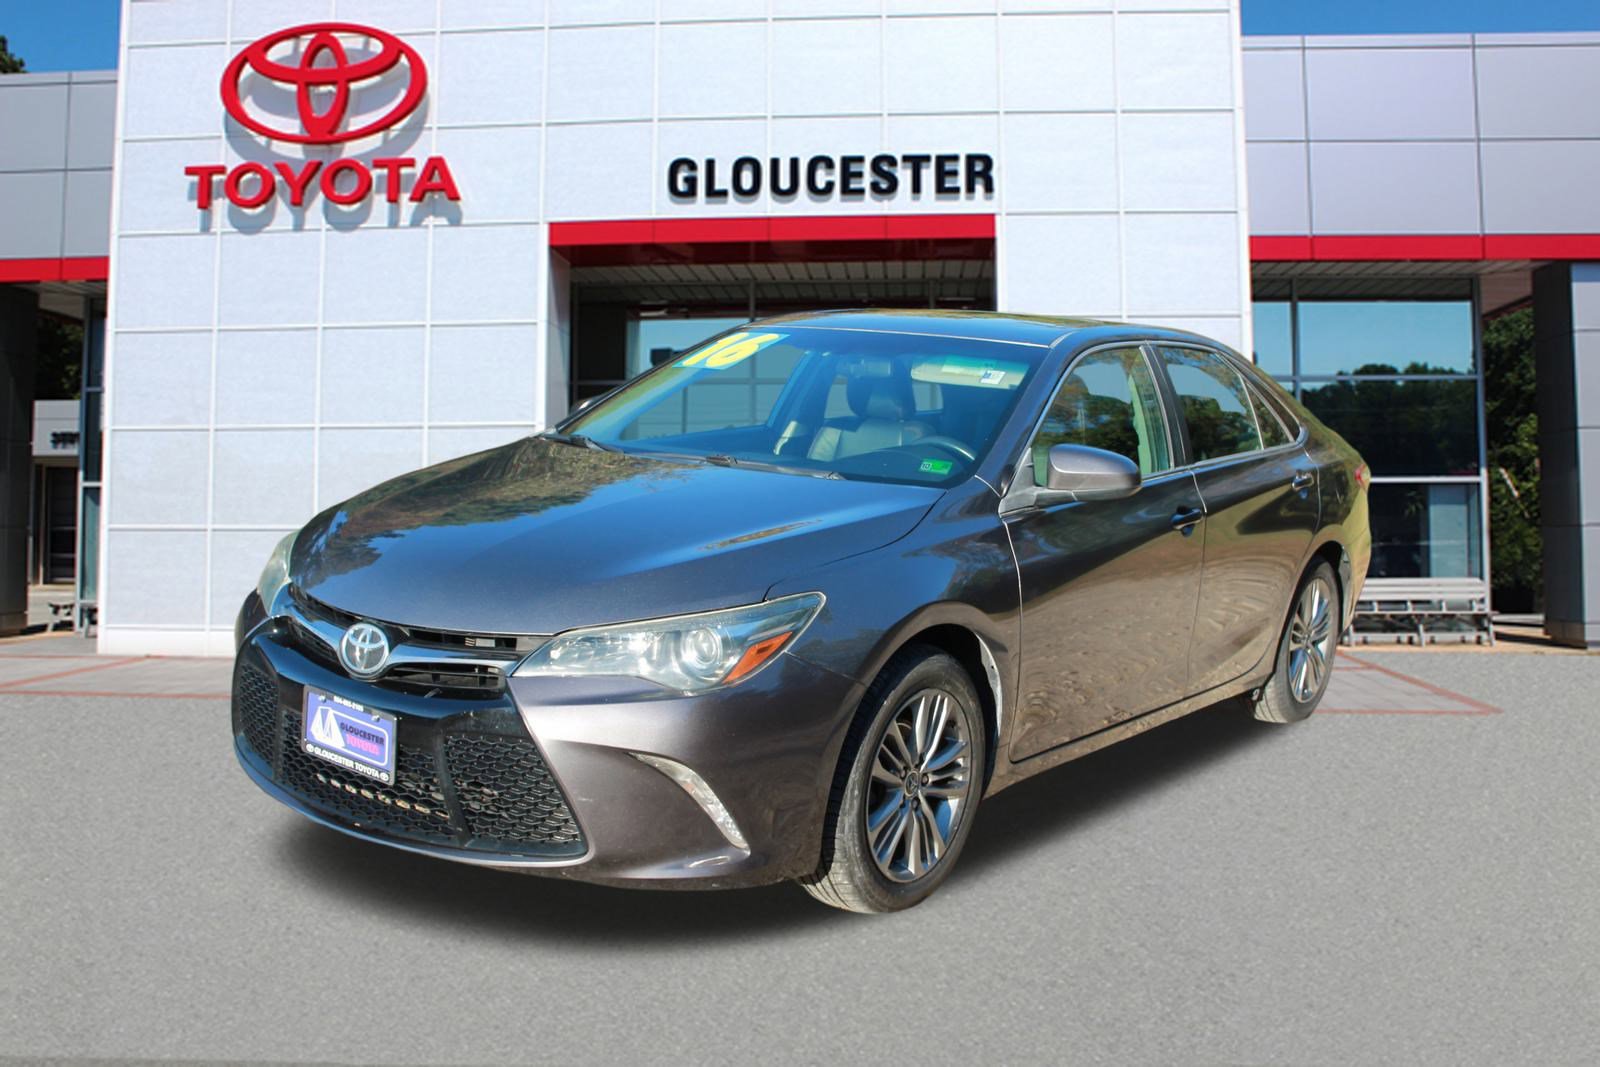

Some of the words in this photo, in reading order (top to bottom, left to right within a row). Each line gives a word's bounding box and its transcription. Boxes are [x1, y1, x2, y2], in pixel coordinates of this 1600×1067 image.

[184, 156, 461, 210] TOYOTA
[668, 153, 994, 198] GLOUCESTER
[682, 332, 779, 368] 16
[340, 722, 385, 745] GLOUCESTER
[346, 733, 380, 756] TOYOTA
[314, 747, 354, 768] GLOUCESTER
[354, 762, 379, 779] TOYOTA
